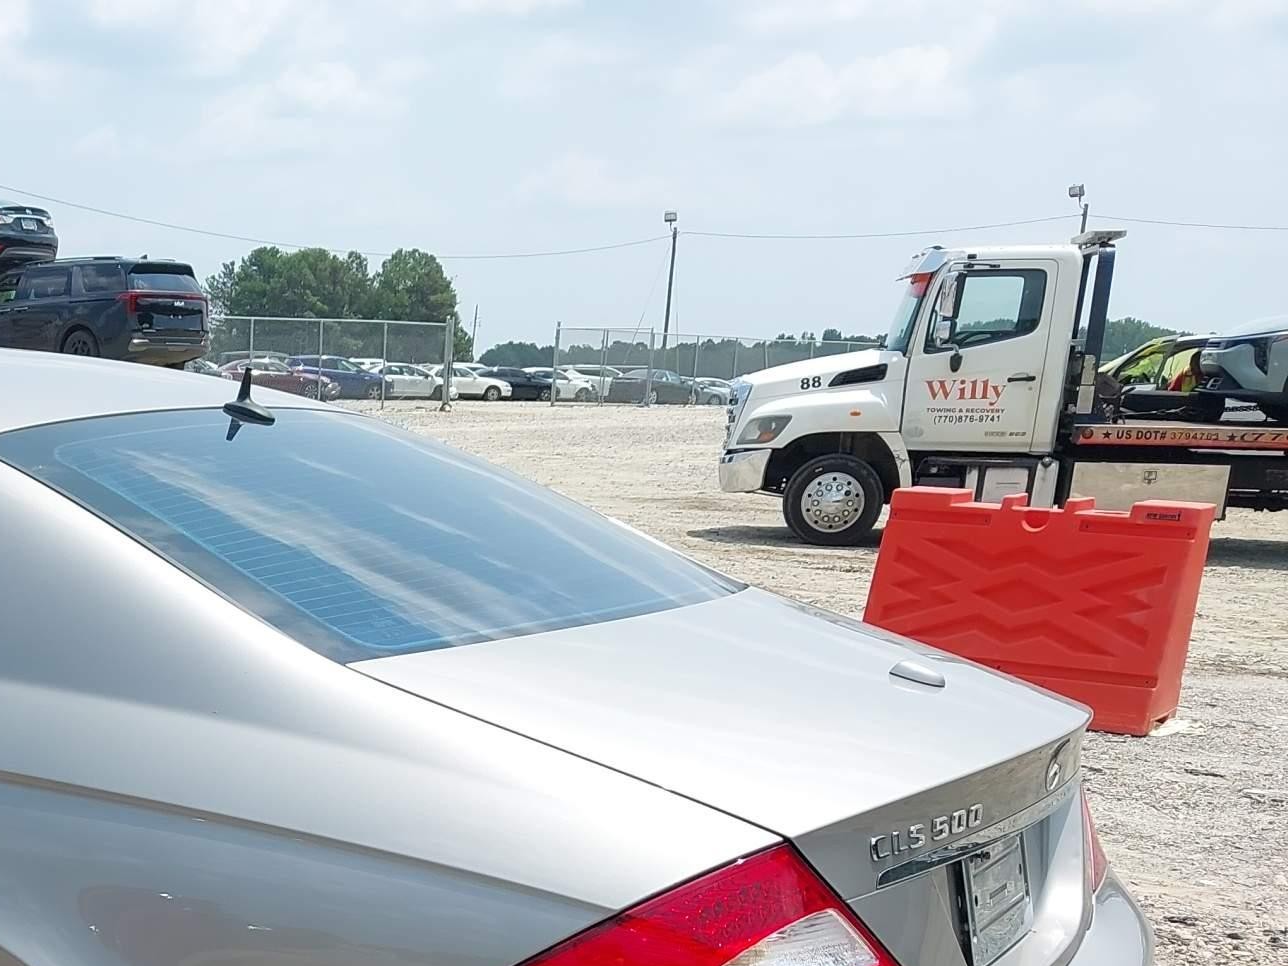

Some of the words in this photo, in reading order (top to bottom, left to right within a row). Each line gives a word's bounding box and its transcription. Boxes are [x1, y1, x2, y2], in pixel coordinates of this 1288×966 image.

[800, 376, 821, 390] 88
[925, 378, 1007, 406] Willy
[933, 414, 1000, 425] (770)876-9741
[1116, 430, 1132, 440] US
[1135, 430, 1166, 440] DOT#
[1240, 432, 1288, 441] (77
[870, 824, 926, 861] CLS
[931, 803, 984, 841] 500
